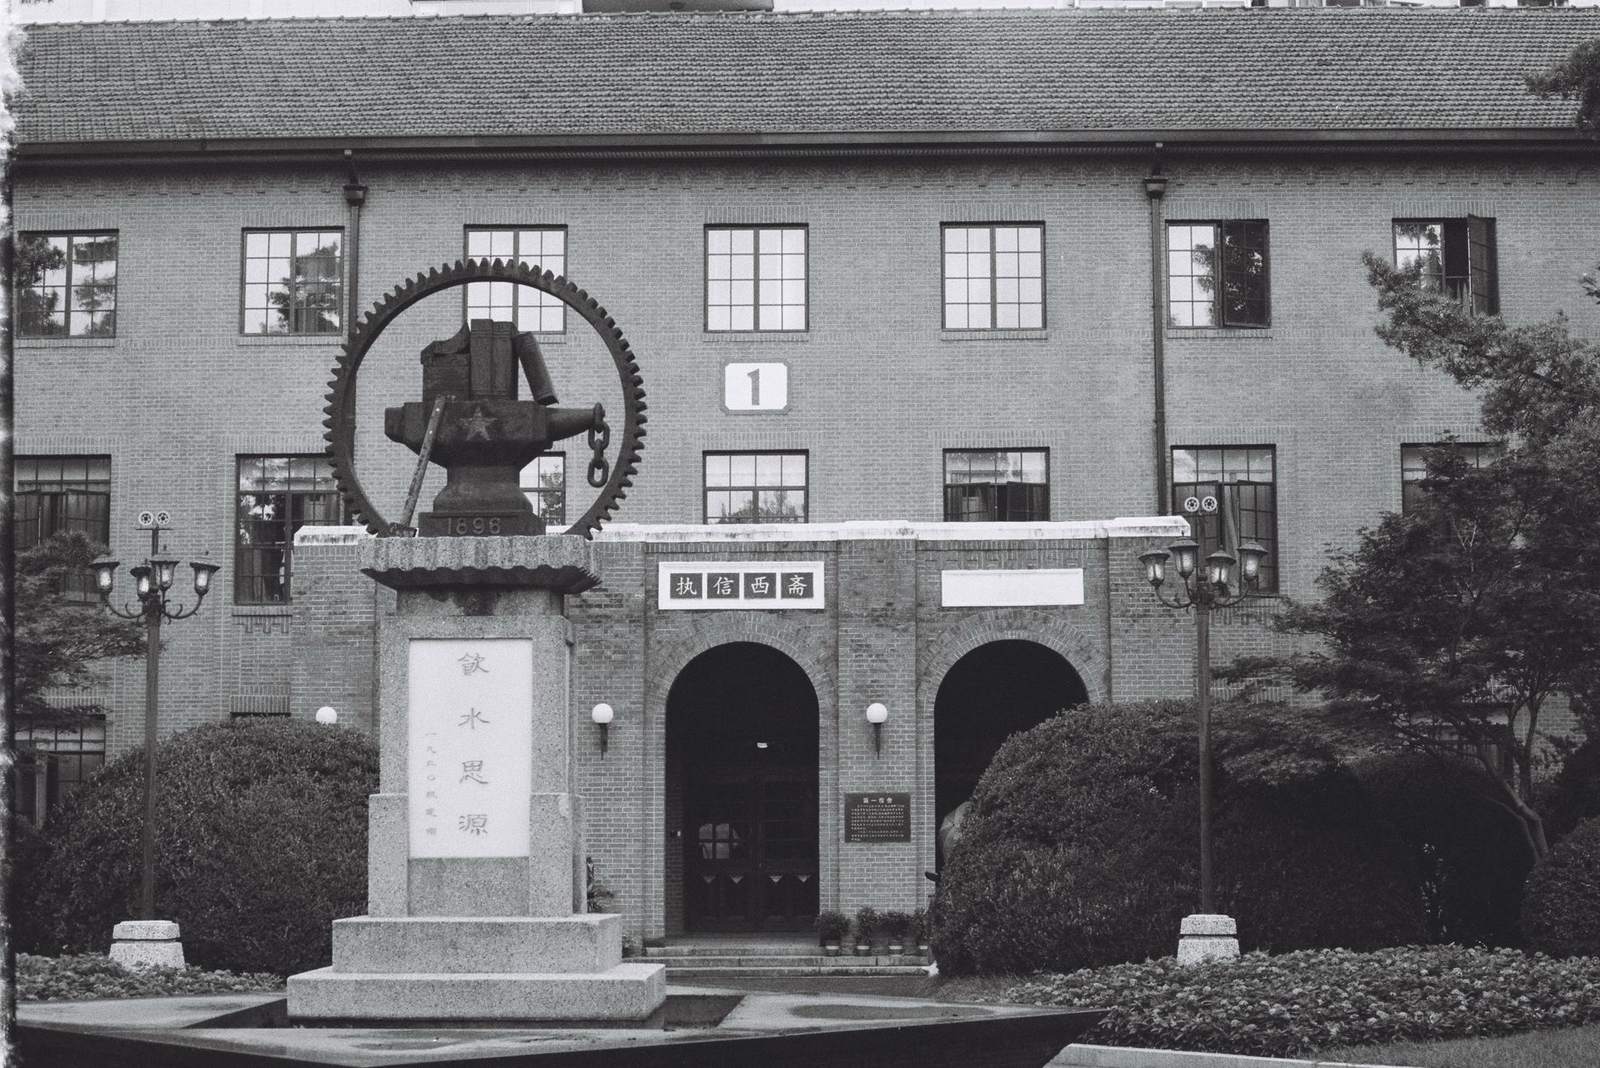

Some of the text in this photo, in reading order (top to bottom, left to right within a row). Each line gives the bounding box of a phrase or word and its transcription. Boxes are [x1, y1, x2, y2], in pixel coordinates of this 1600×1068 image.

[747, 368, 760, 406] 1
[448, 517, 501, 535] 1896
[675, 574, 808, 596] 执信西斋
